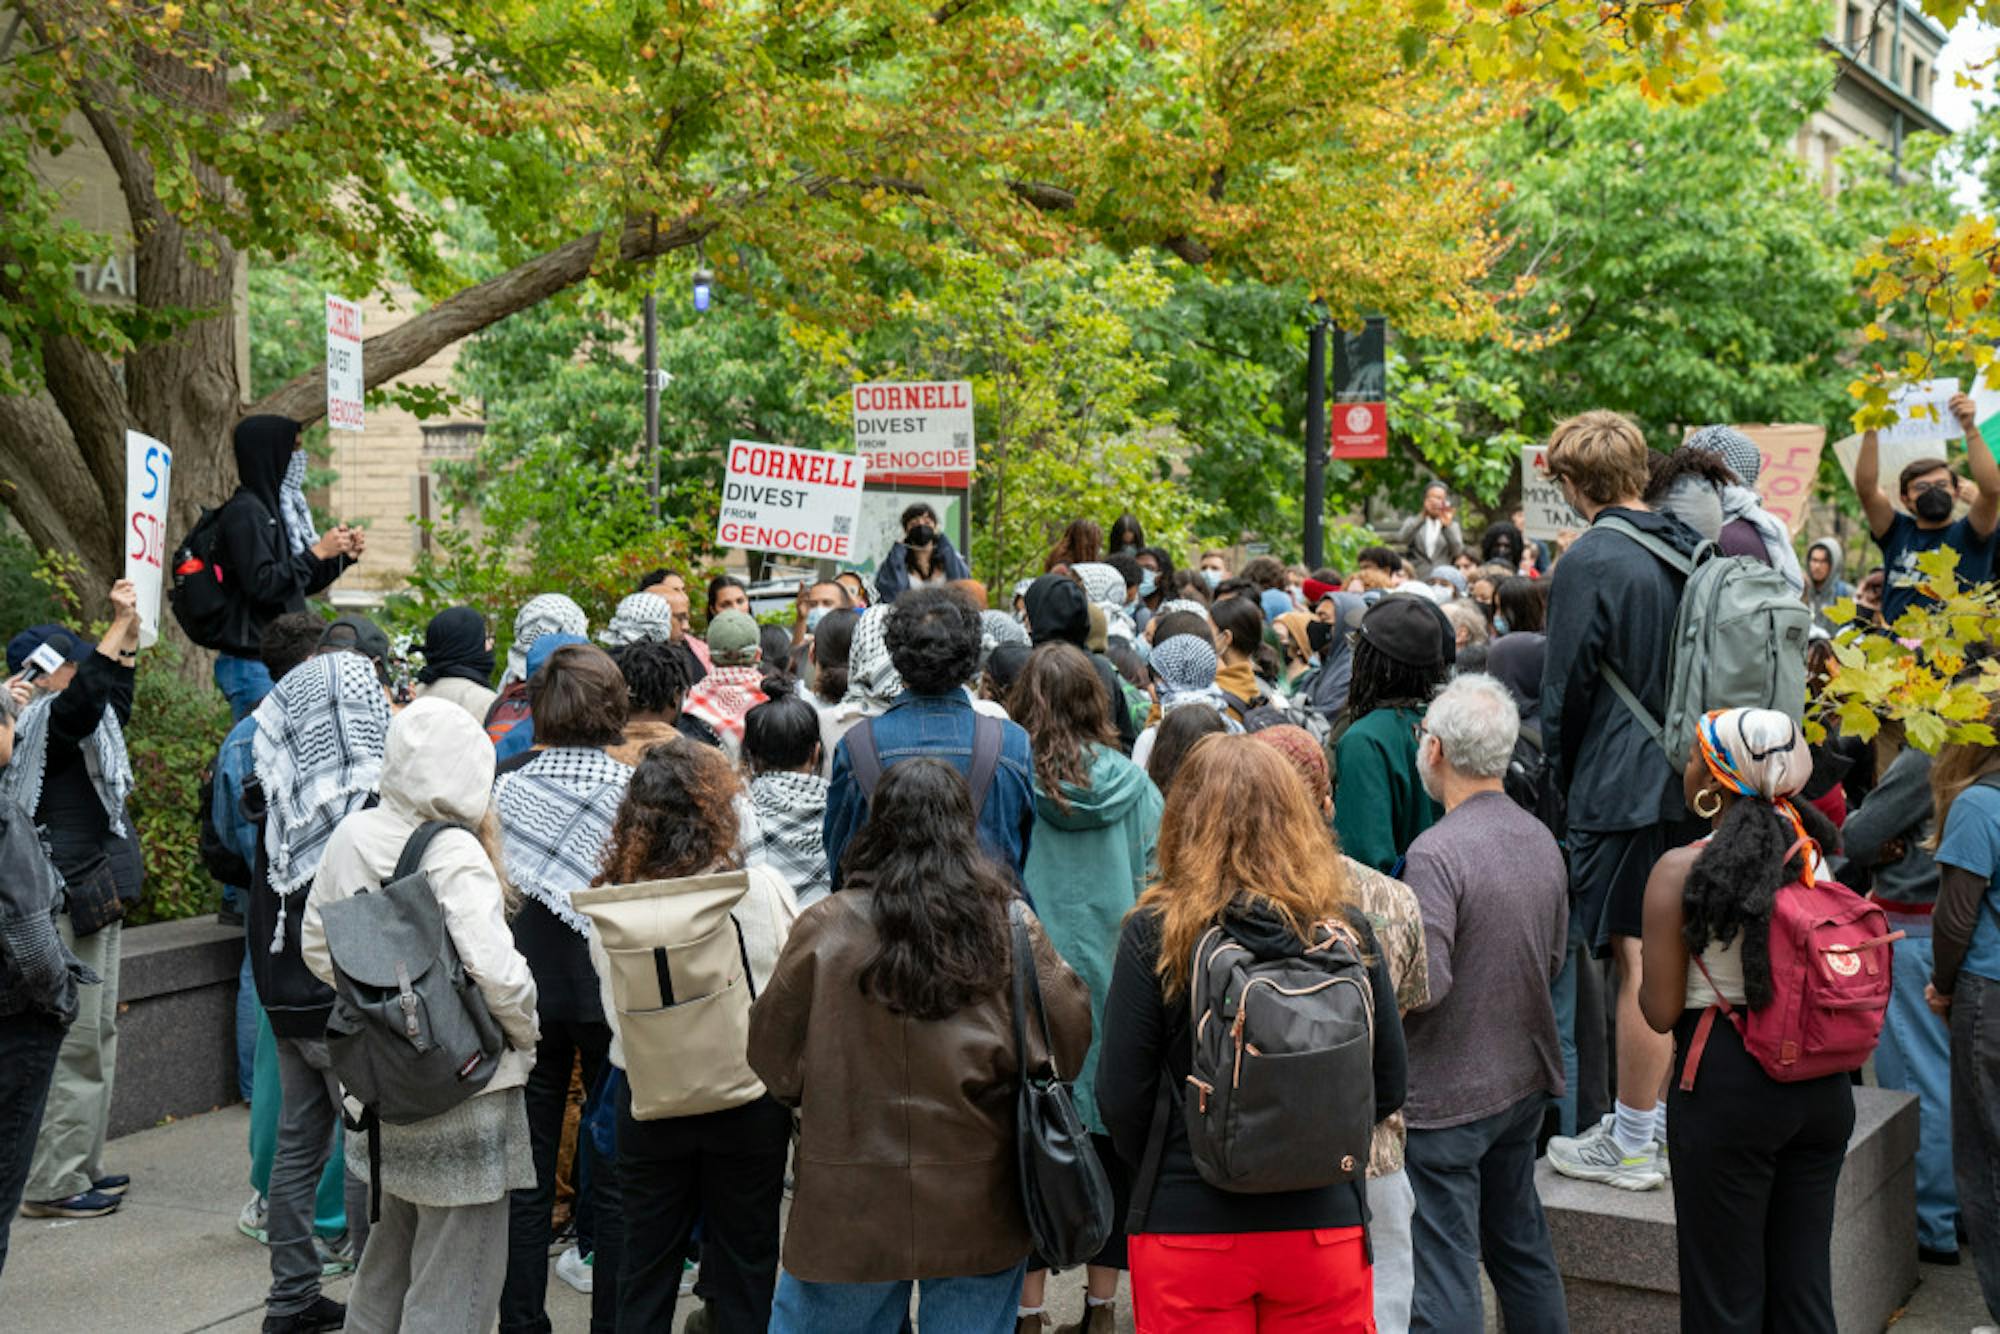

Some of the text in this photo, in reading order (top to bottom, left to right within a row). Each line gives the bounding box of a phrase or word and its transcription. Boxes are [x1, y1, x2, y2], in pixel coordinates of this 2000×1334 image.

[856, 384, 967, 411] CORNELL
[857, 417, 927, 434] DIVEST
[858, 440, 887, 449] FROM
[731, 445, 857, 488] CORNELL
[727, 483, 808, 509] DIVEST
[724, 507, 757, 520] FROM
[721, 523, 849, 556] GENOCIDE
